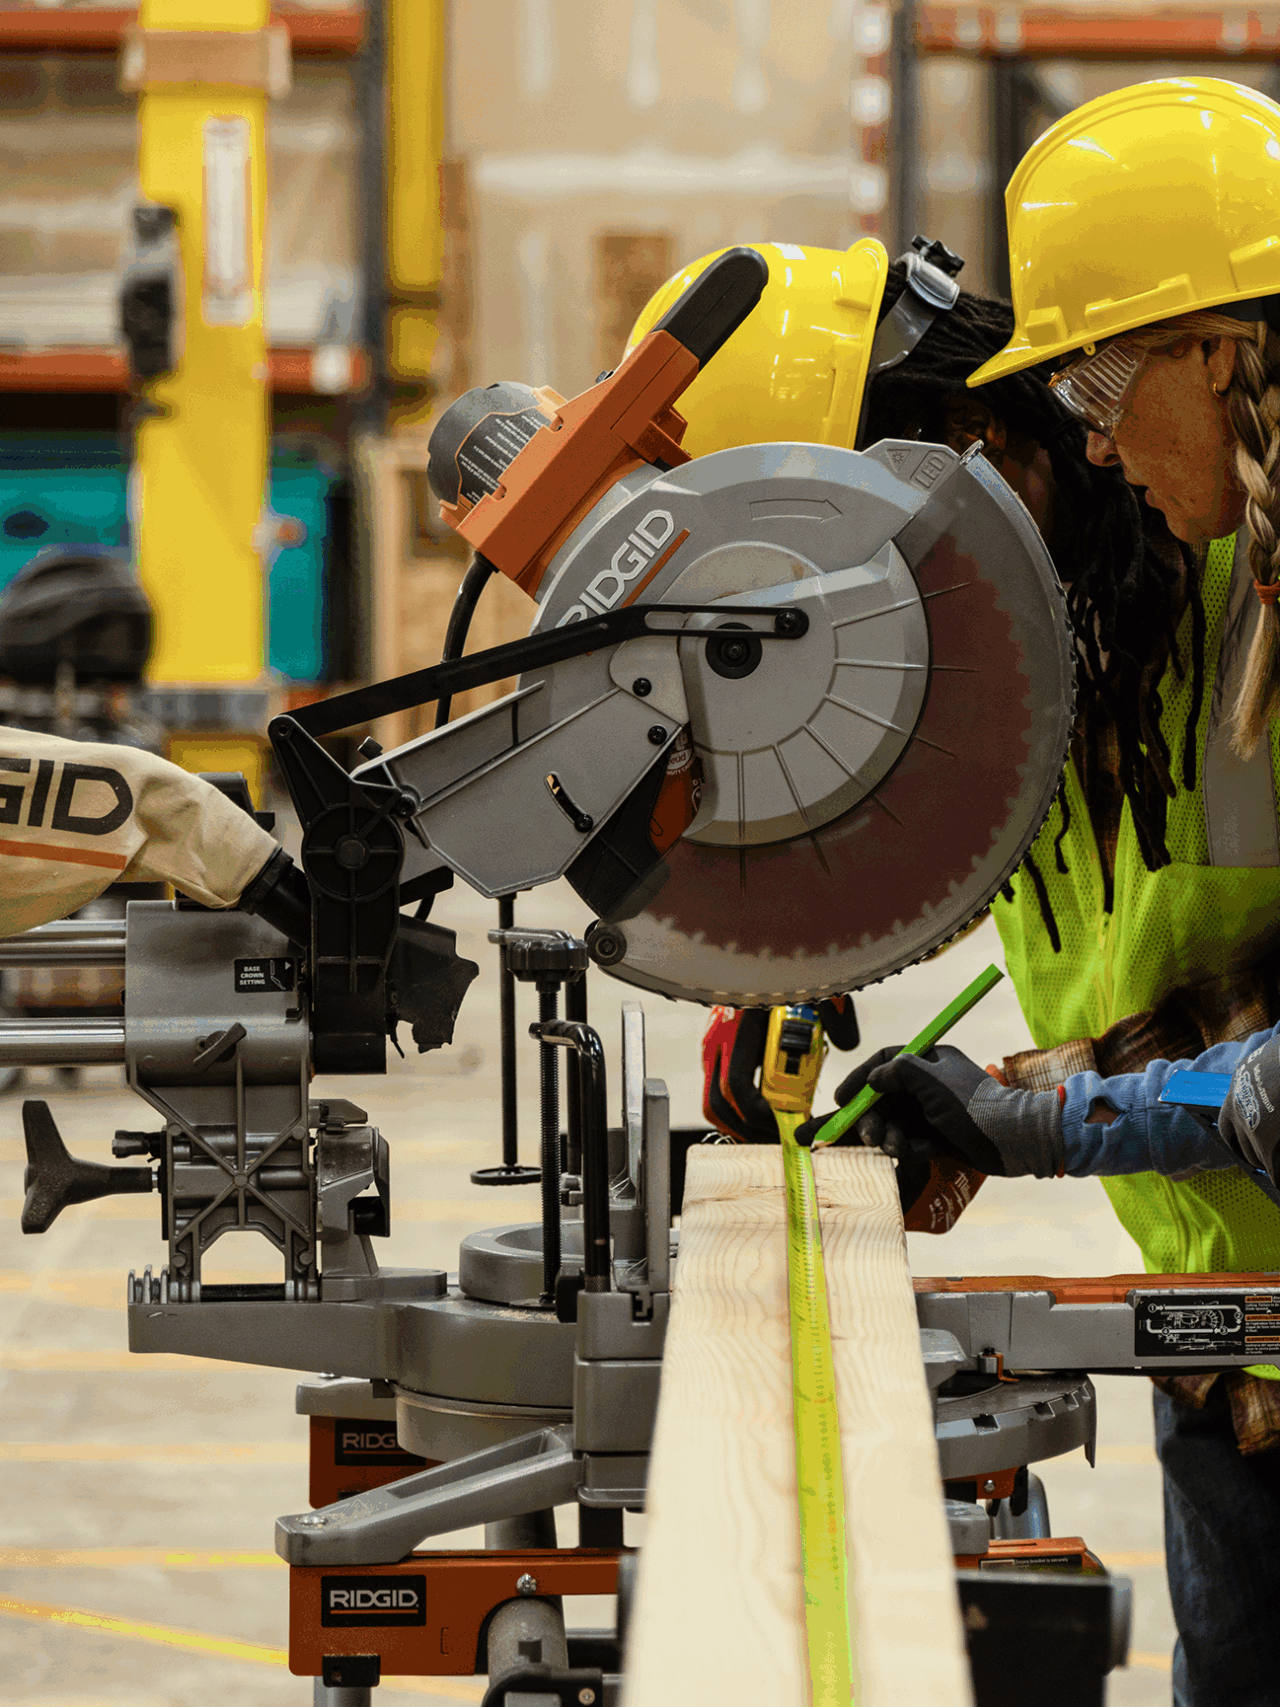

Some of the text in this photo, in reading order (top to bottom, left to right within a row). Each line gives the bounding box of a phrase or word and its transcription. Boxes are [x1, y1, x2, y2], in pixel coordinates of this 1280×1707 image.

[914, 454, 946, 489] LED
[343, 1433, 396, 1448] RIDG
[329, 1589, 418, 1608] RIDGID
